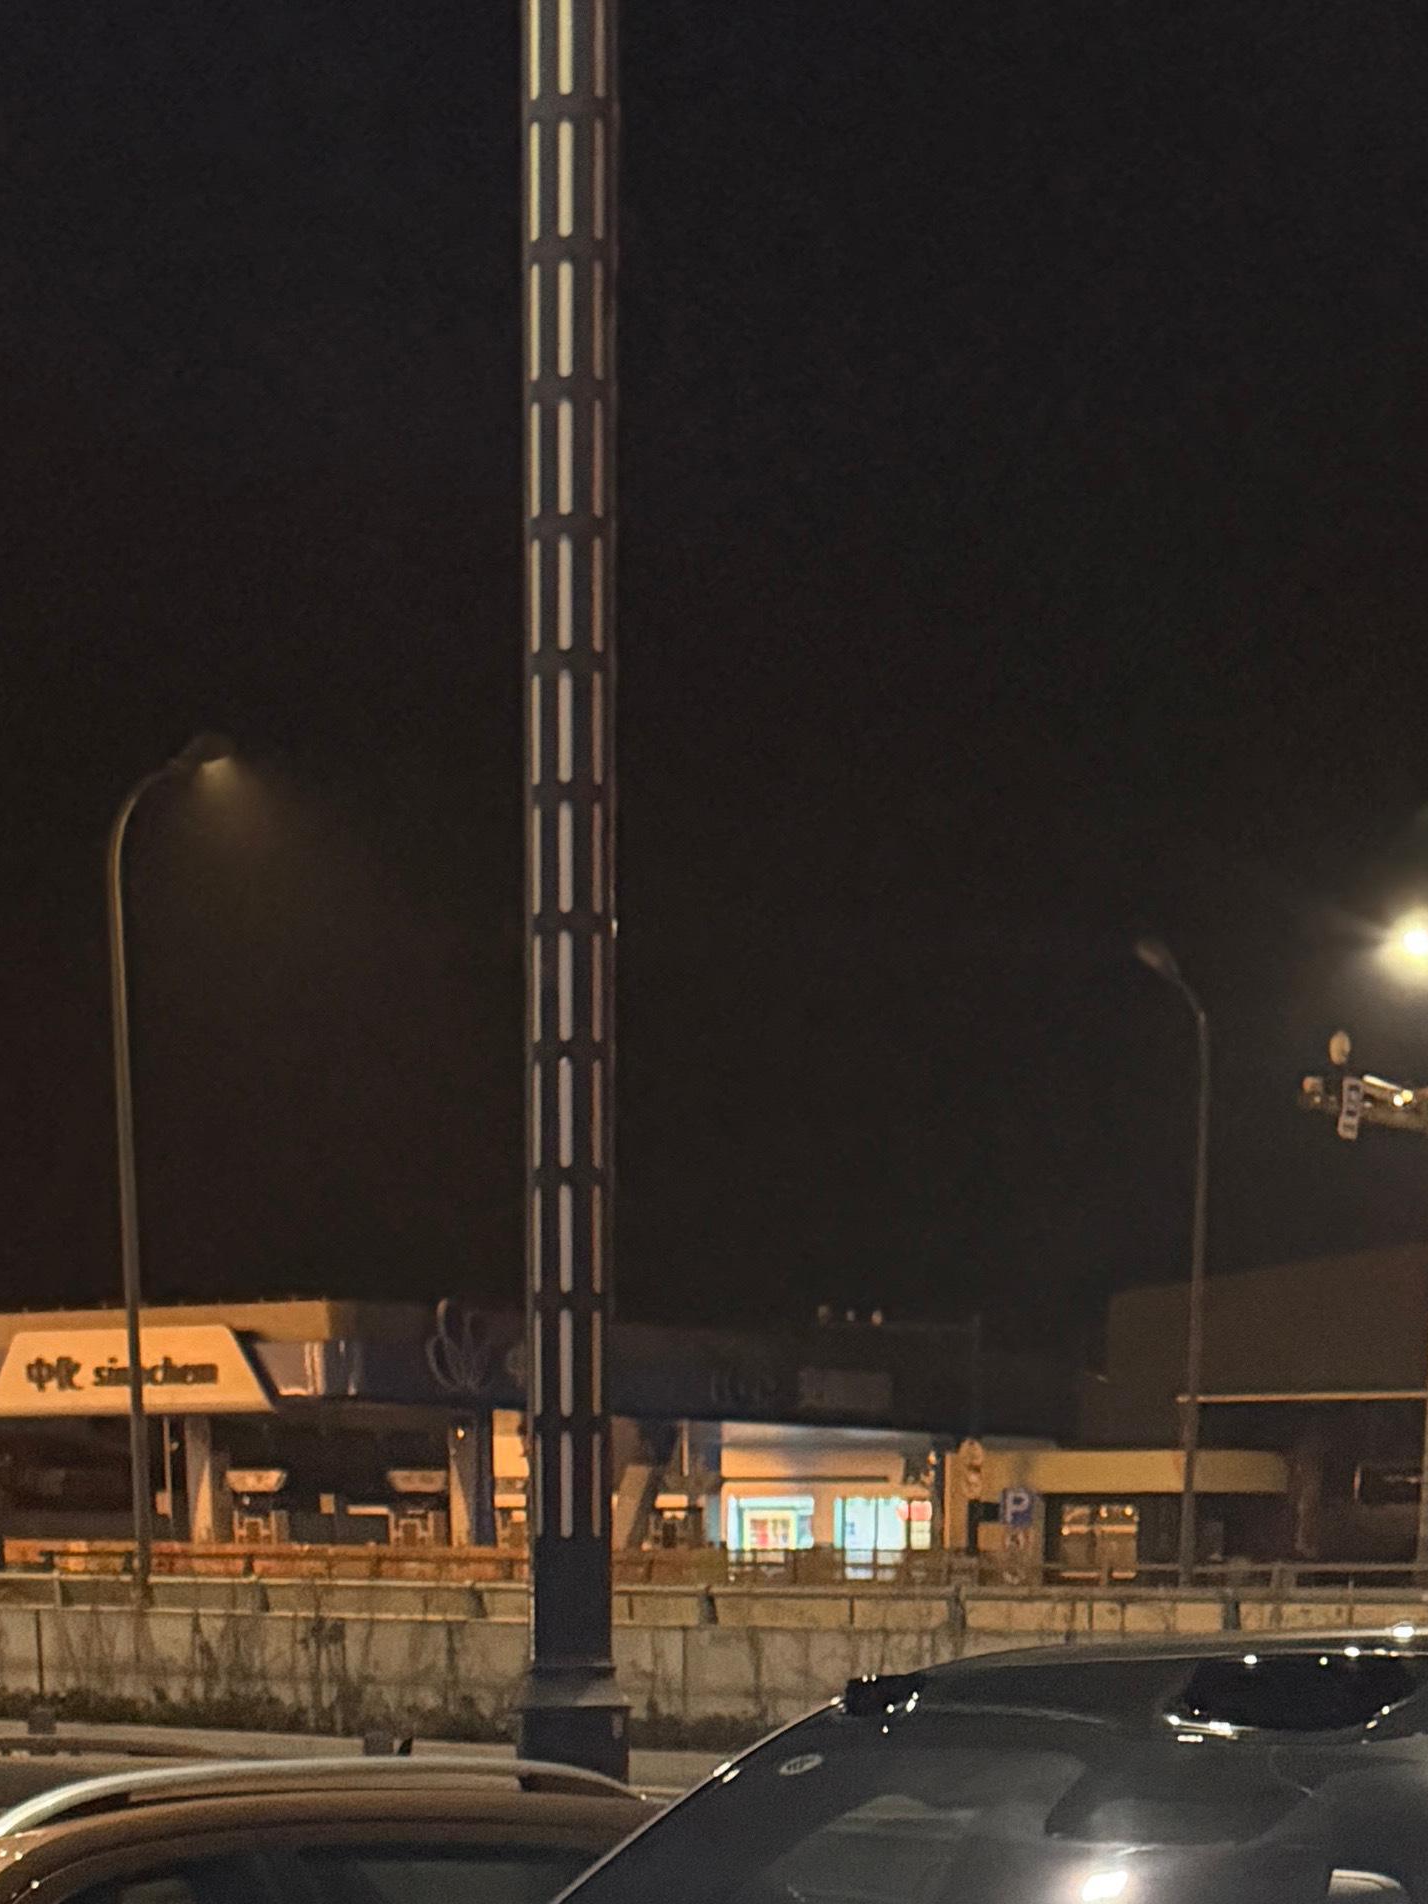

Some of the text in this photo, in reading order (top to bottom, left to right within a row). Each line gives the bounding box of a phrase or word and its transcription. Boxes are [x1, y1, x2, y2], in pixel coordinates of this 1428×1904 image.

[25, 1356, 219, 1392] 中化 sinchem
[1005, 1492, 1031, 1523] P
